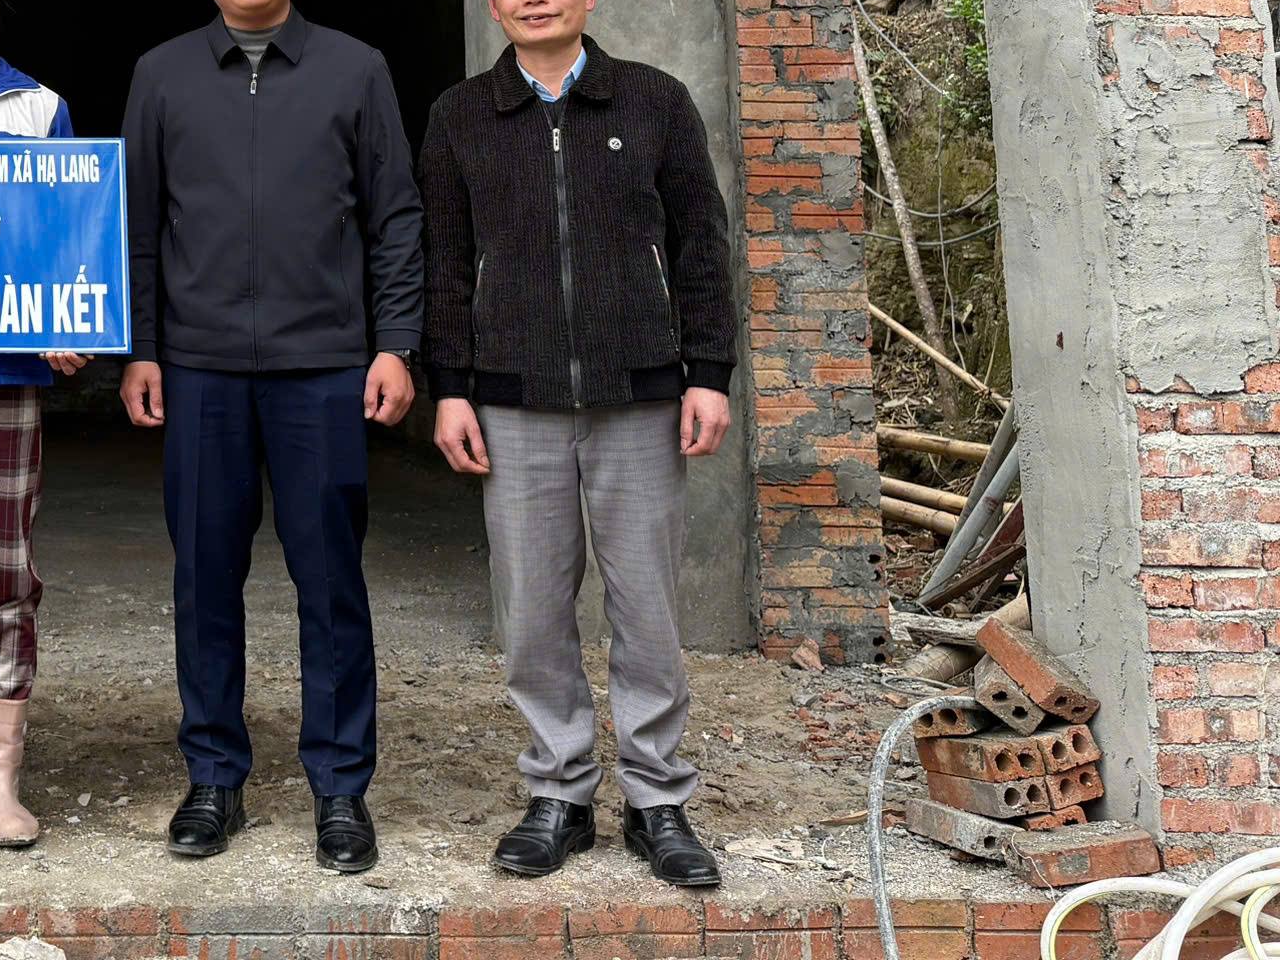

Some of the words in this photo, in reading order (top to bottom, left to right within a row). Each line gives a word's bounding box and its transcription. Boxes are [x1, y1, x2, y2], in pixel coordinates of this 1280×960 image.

[12, 150, 33, 183] XÃ
[37, 154, 57, 187] HẠ
[61, 154, 100, 184] LANG
[52, 265, 108, 333] KẾT
